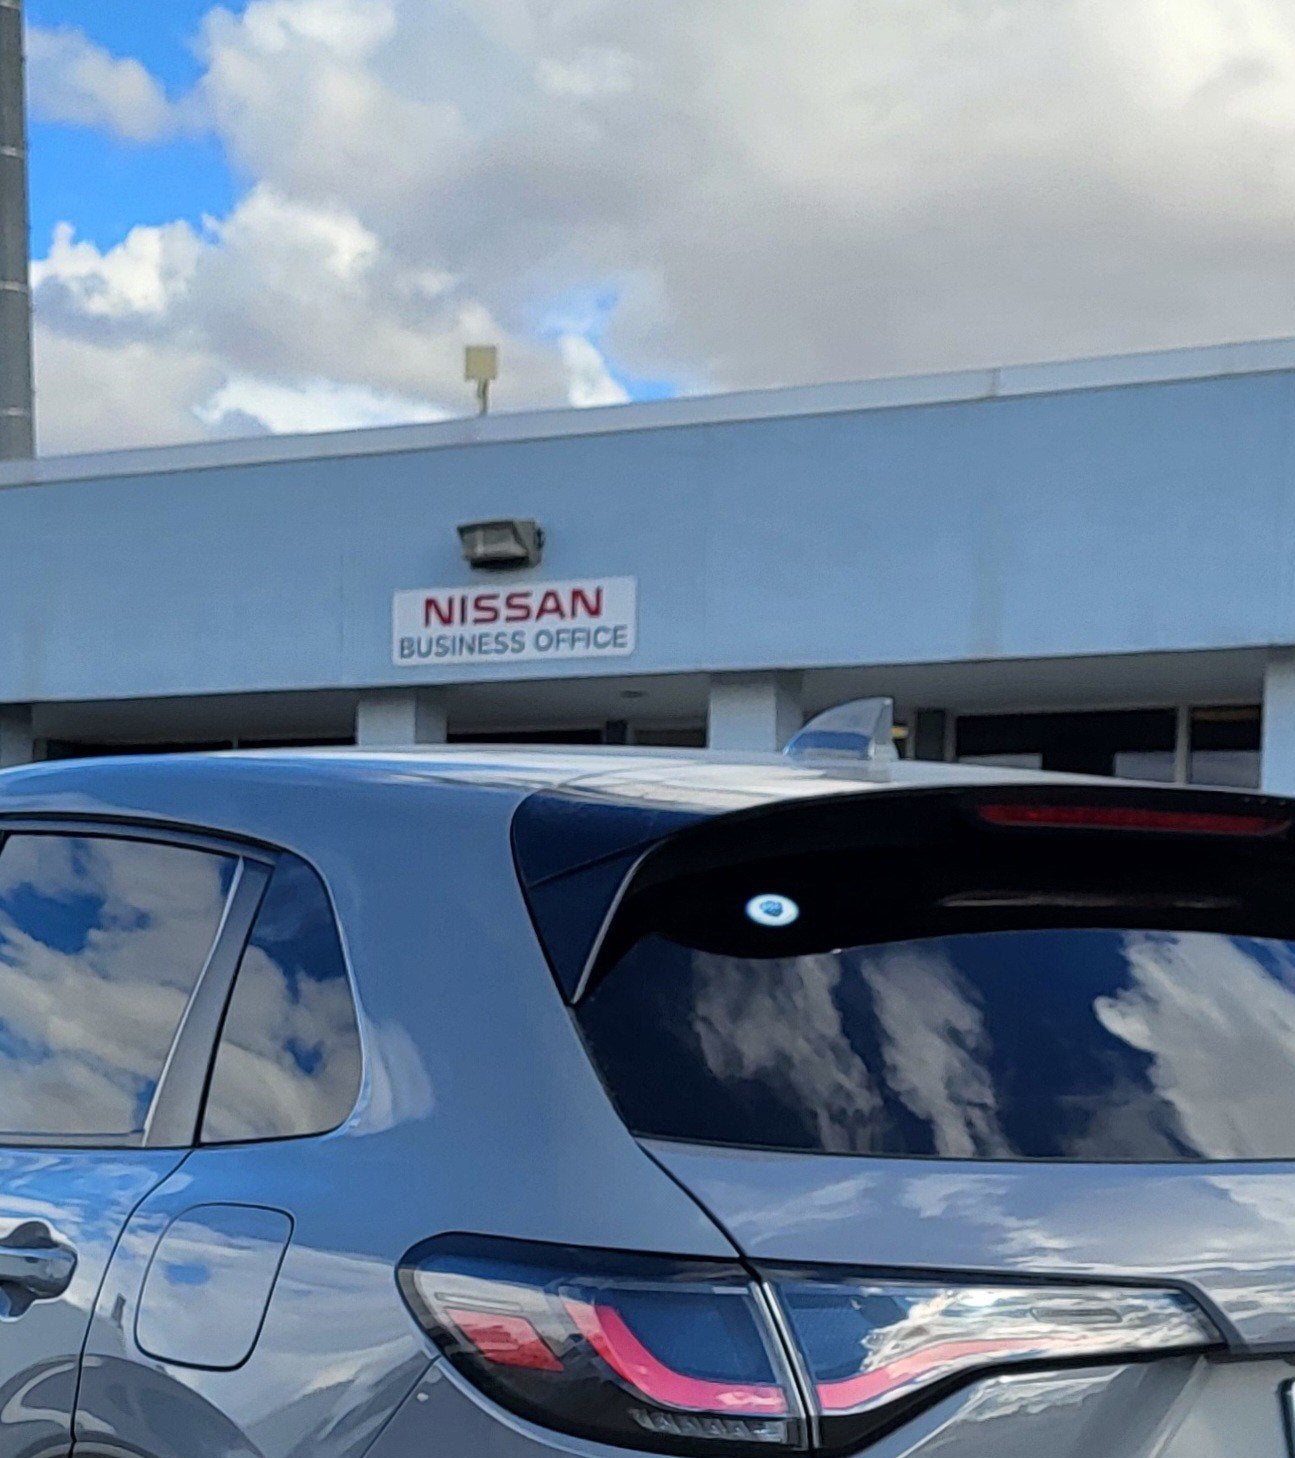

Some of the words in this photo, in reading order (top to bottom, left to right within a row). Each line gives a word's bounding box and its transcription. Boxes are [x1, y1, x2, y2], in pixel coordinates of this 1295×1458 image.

[423, 585, 604, 628] NISSAN
[399, 629, 526, 659] BUSINESS
[533, 624, 629, 652] OFFICE
